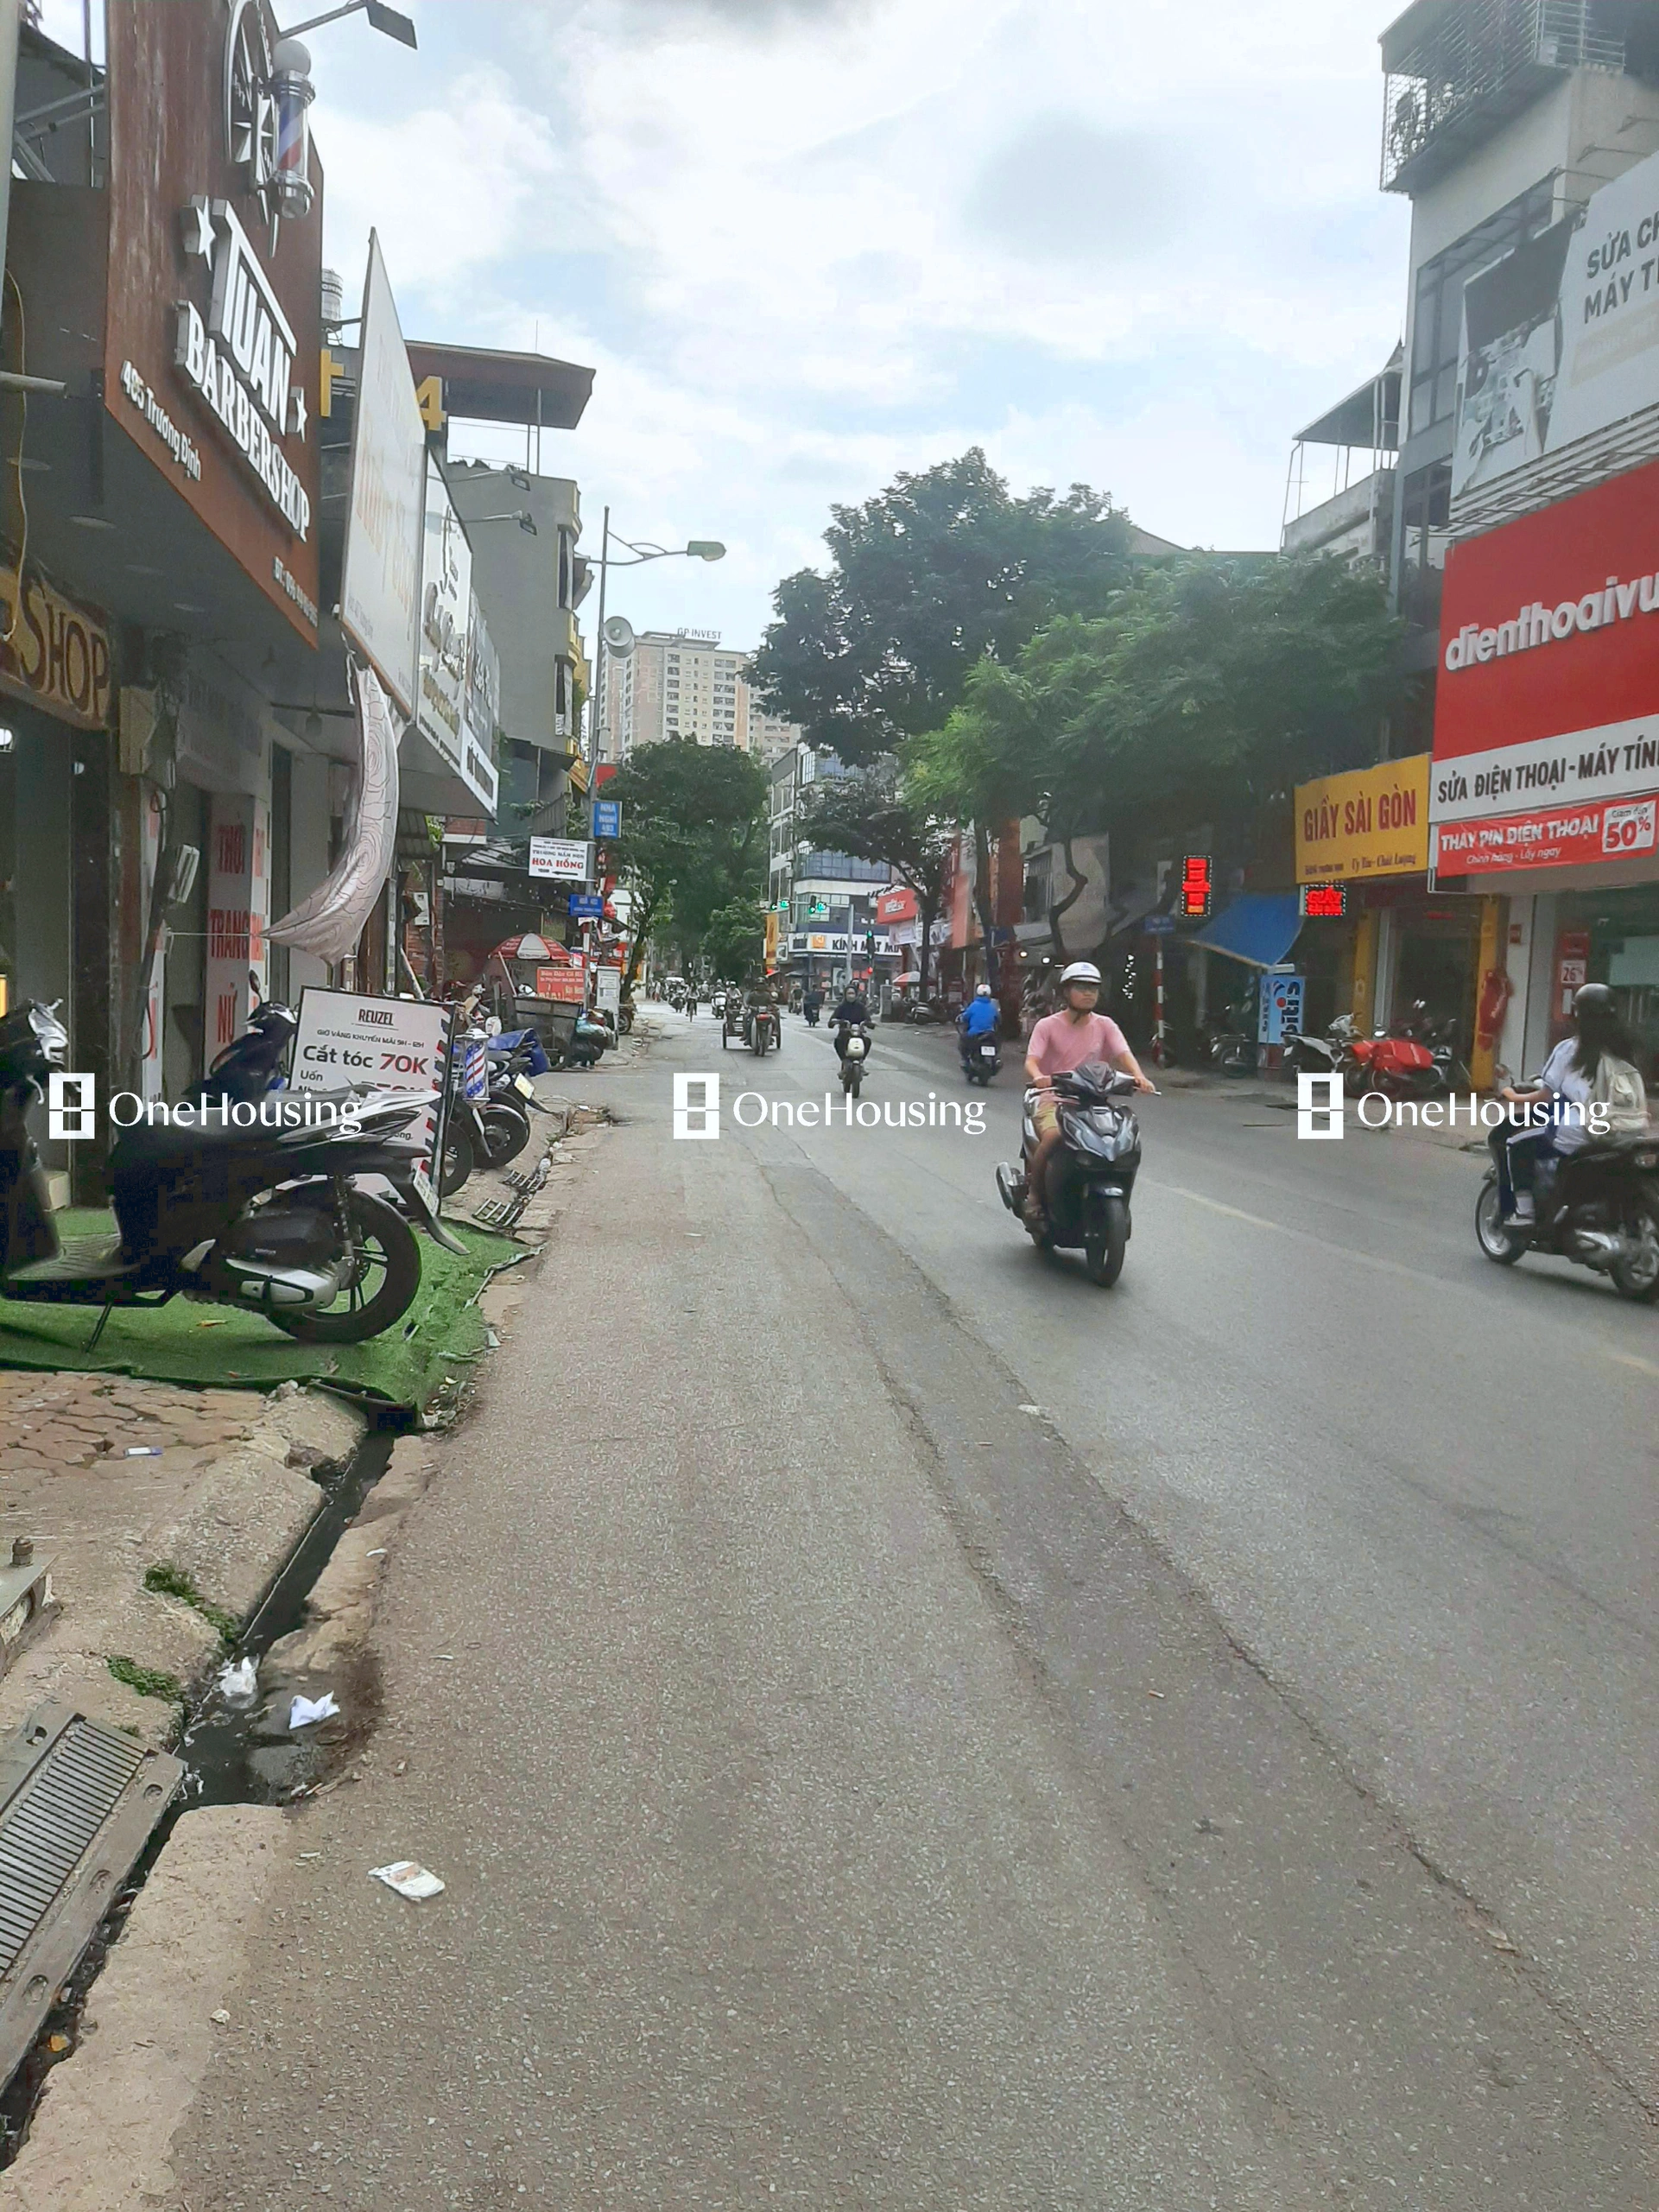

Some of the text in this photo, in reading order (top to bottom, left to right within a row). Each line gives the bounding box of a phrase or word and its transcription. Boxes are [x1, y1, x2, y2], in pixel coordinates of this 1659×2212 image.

[1586, 230, 1631, 279] SỬA
[221, 200, 297, 436] TUAN
[1585, 269, 1635, 325] MÁY
[186, 300, 311, 543] BARBERSHOP
[691, 628, 722, 640] INVEST
[1438, 770, 1467, 803] SỬA
[1474, 764, 1511, 801] ĐIỆN
[1516, 757, 1567, 791] THOẠI
[1578, 741, 1620, 780] MÁY
[1345, 790, 1372, 835] SÀI
[1378, 783, 1416, 831] GÒN
[1441, 814, 1598, 852] THAY PIN ĐIỆN THOẠI
[532, 857, 553, 866] HOA
[358, 1008, 395, 1026] REUZEL
[300, 1069, 323, 1081] Uốn
[303, 1044, 429, 1075] Cắt tóc 70K
